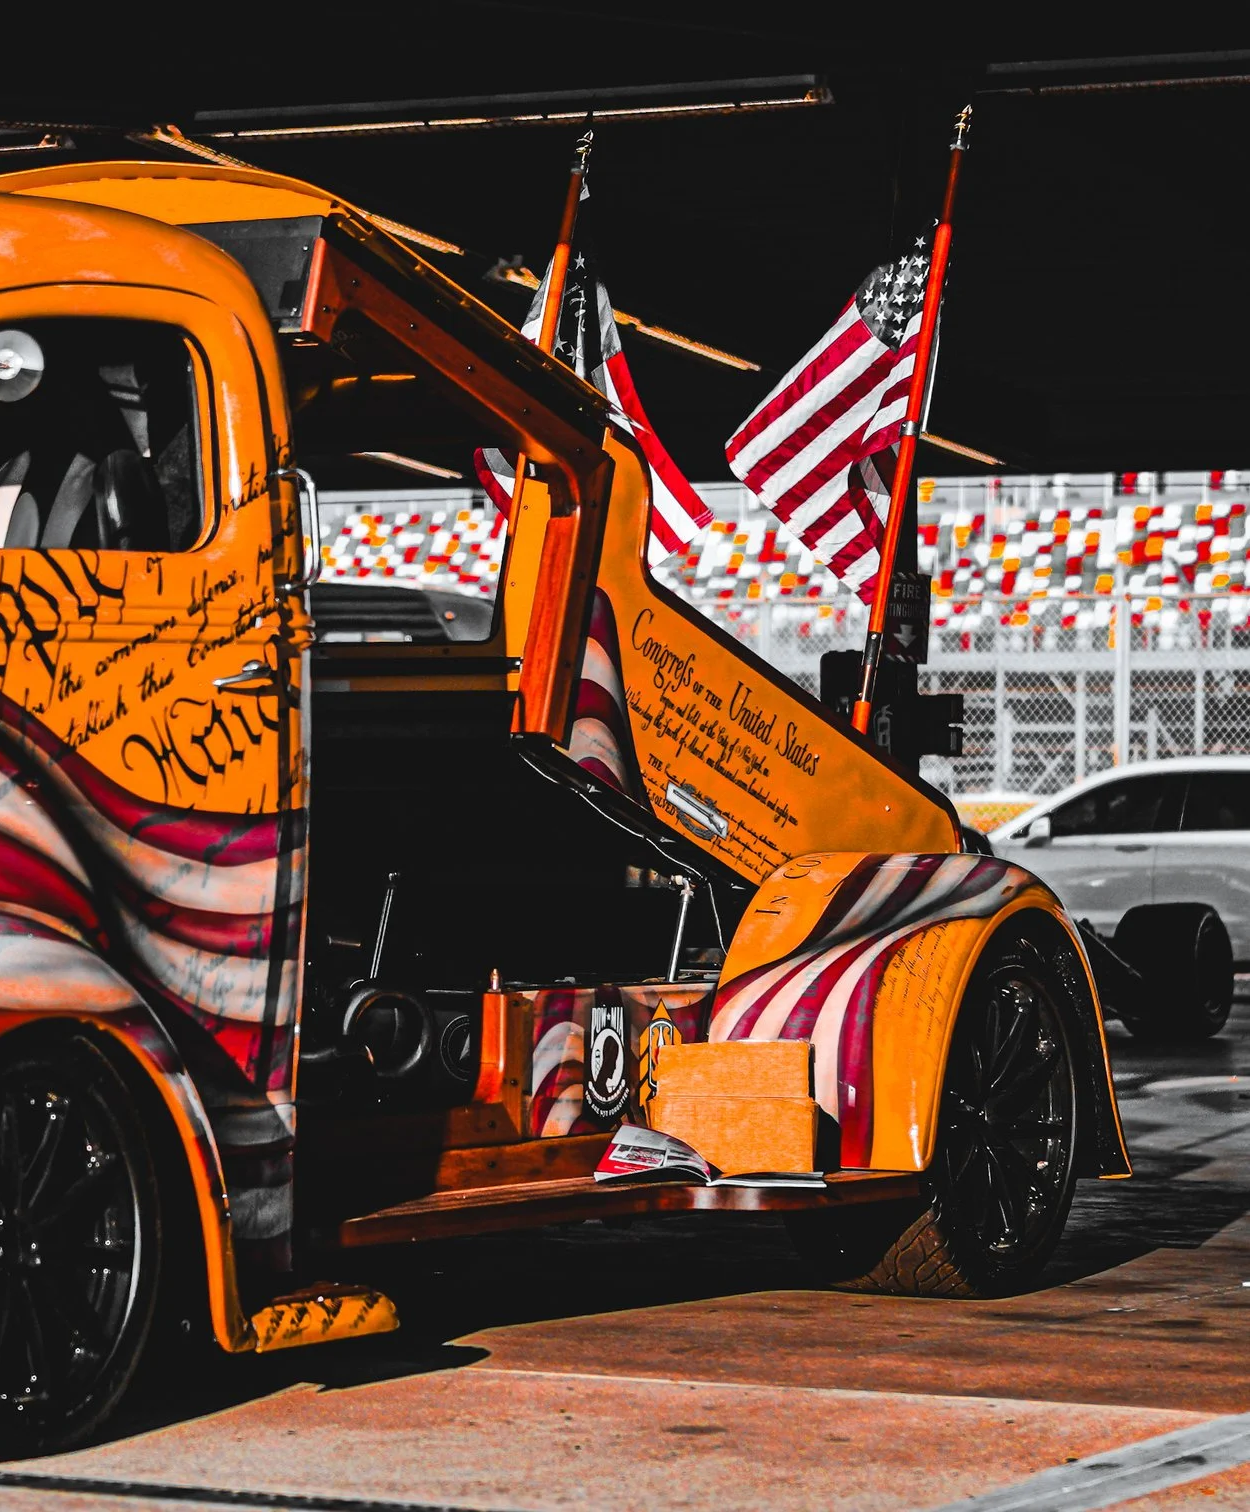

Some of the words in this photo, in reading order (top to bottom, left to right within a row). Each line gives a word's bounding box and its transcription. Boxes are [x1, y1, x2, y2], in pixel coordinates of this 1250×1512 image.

[893, 583, 921, 599] FIRE
[693, 681, 704, 695] OF
[705, 690, 723, 710] THE
[730, 680, 777, 746] United
[775, 721, 820, 777] States
[648, 753, 663, 771] THE
[591, 1007, 607, 1048] POW
[611, 1007, 625, 1047] MIA
